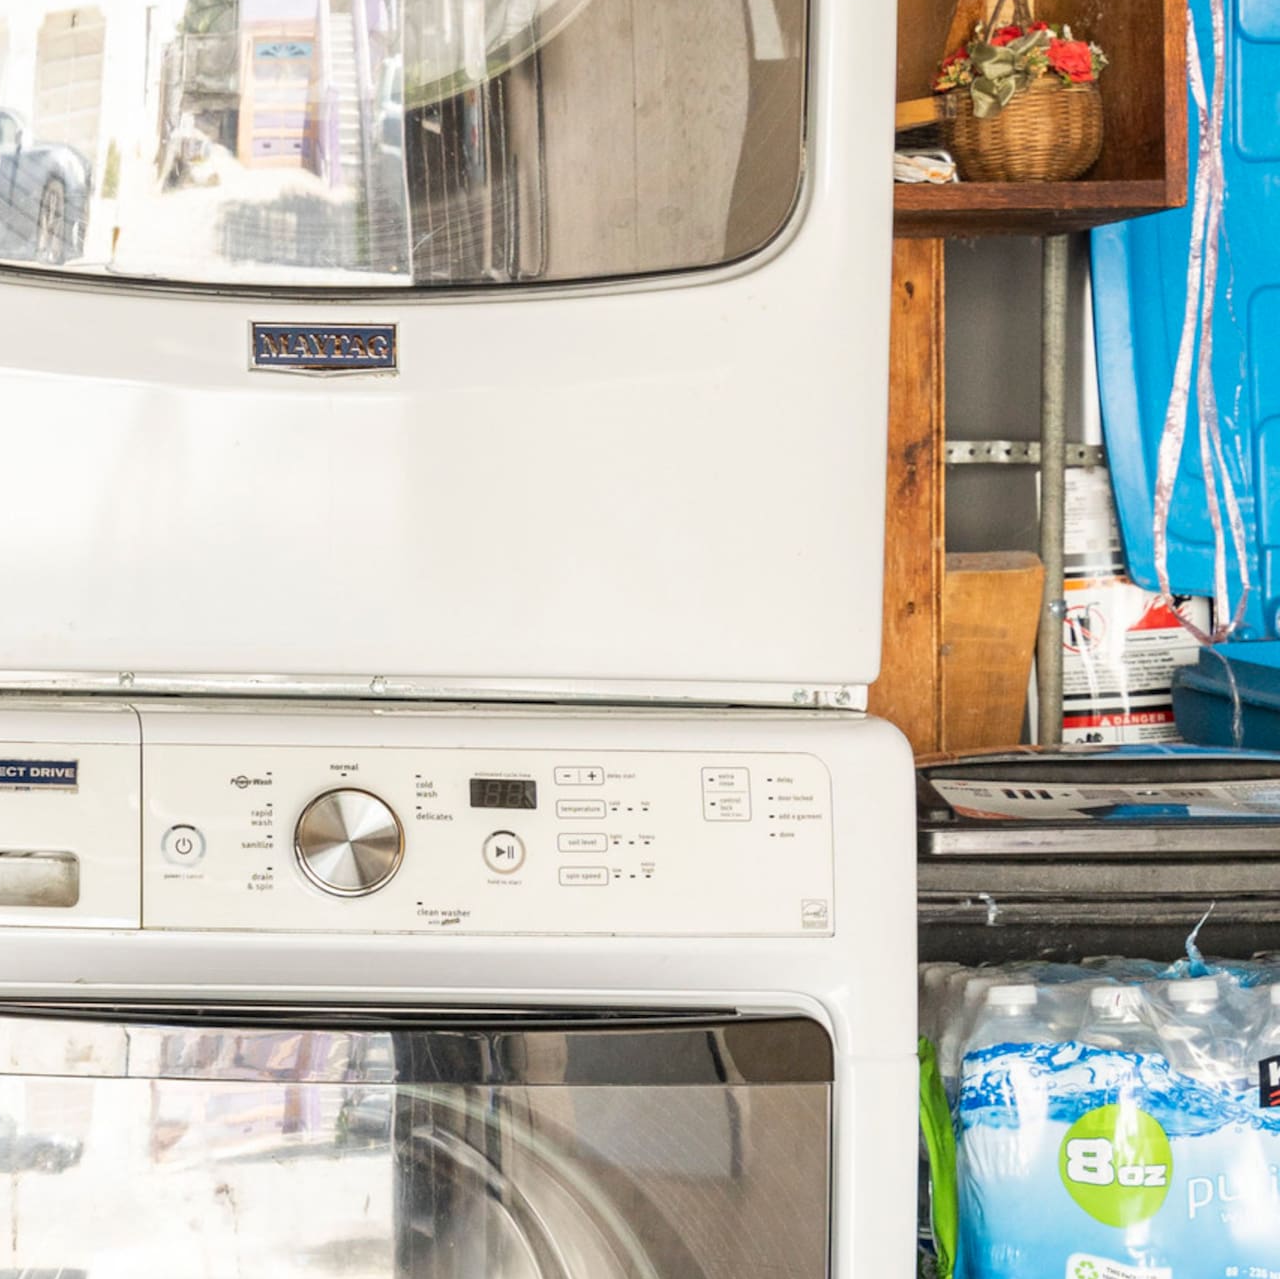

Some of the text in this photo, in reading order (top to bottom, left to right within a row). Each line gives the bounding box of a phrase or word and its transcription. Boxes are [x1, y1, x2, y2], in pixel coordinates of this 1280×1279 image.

[260, 333, 390, 359] MAYTAG
[1113, 713, 1166, 726] DANGER
[330, 763, 359, 771] normal
[29, 767, 74, 778] DRIVE
[416, 781, 433, 789] cold
[251, 809, 273, 818] rapid
[416, 813, 453, 821] delicates
[241, 841, 273, 849] sanitize
[252, 873, 273, 881] drain
[256, 882, 273, 891] spin
[417, 909, 471, 917] clean washer
